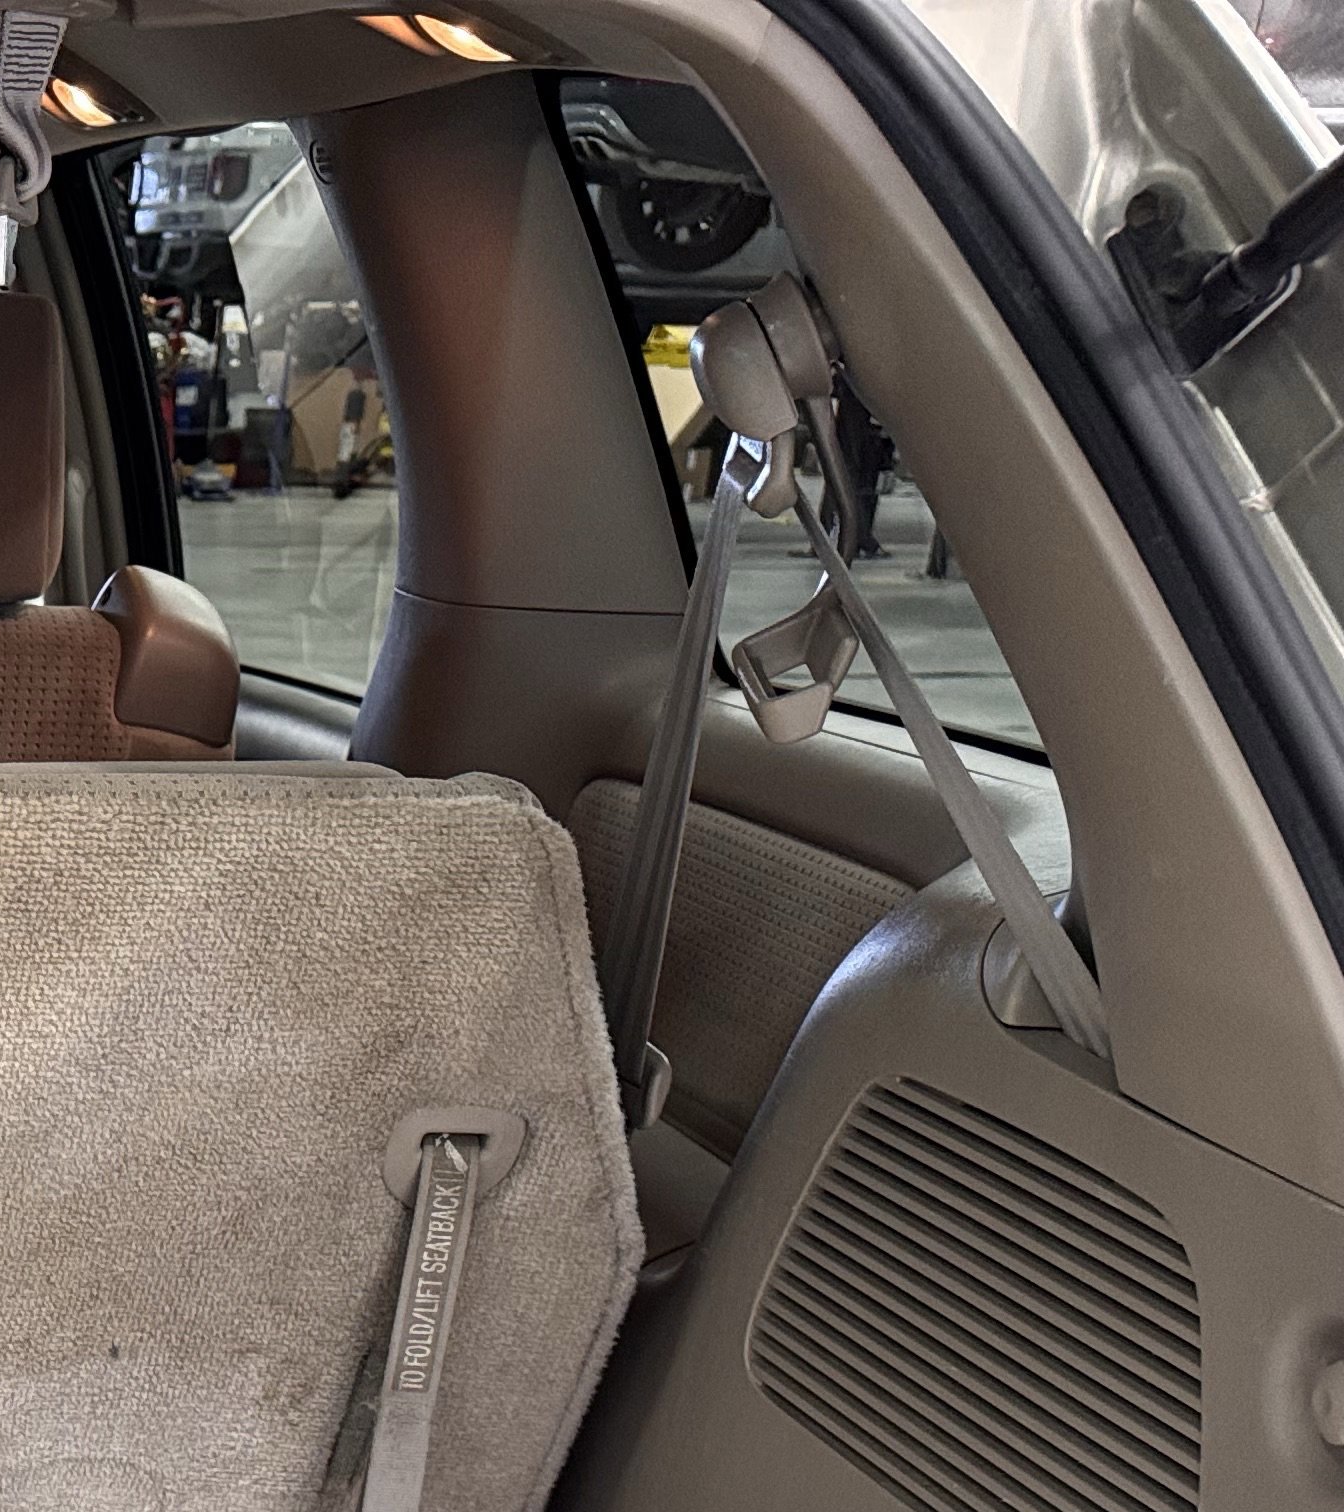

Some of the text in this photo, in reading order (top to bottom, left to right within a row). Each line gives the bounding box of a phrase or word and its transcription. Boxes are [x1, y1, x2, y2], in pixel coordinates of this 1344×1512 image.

[398, 1184, 462, 1390] TO FOLD/LIFT SEATBACK
